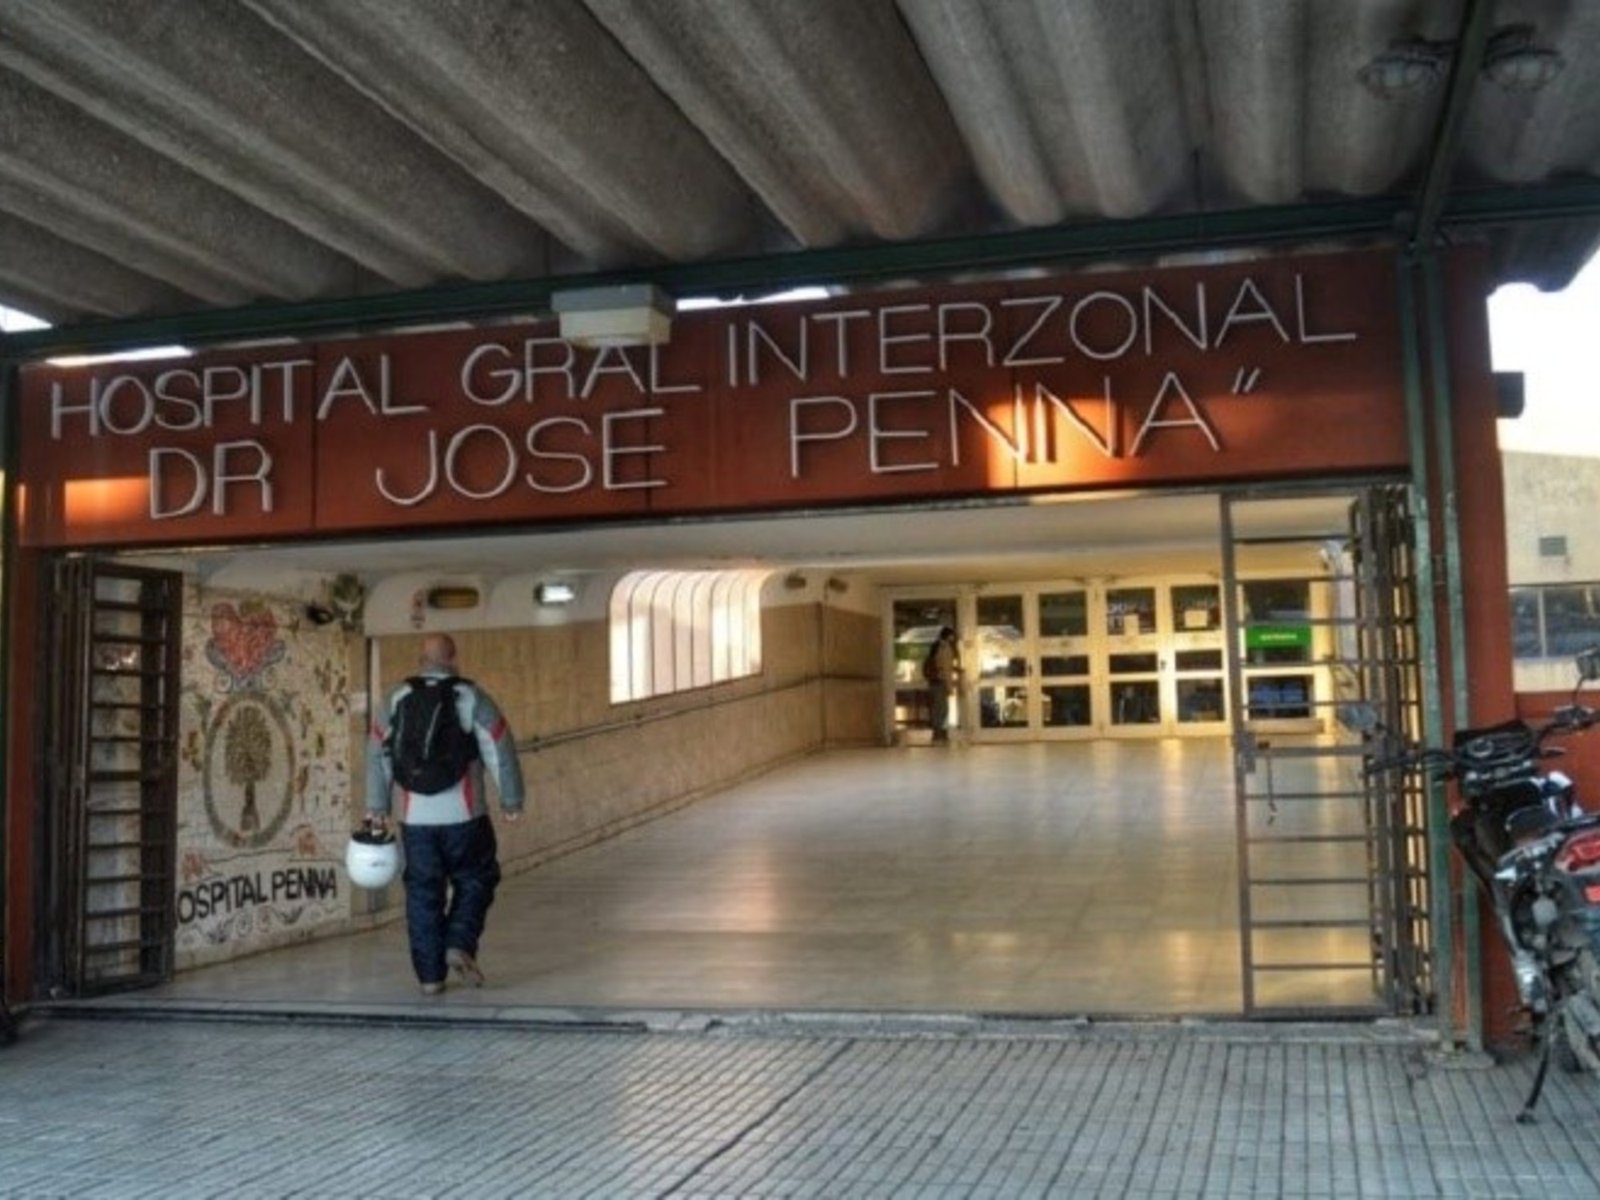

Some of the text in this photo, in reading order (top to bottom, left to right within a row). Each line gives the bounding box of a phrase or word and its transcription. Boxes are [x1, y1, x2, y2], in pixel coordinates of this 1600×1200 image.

[50, 273, 1357, 438] HOSPITAL GRAL INTERZONAL
[149, 440, 274, 520] DR
[374, 407, 669, 506] JOSE
[176, 868, 337, 924] OSPITAL PENNA
